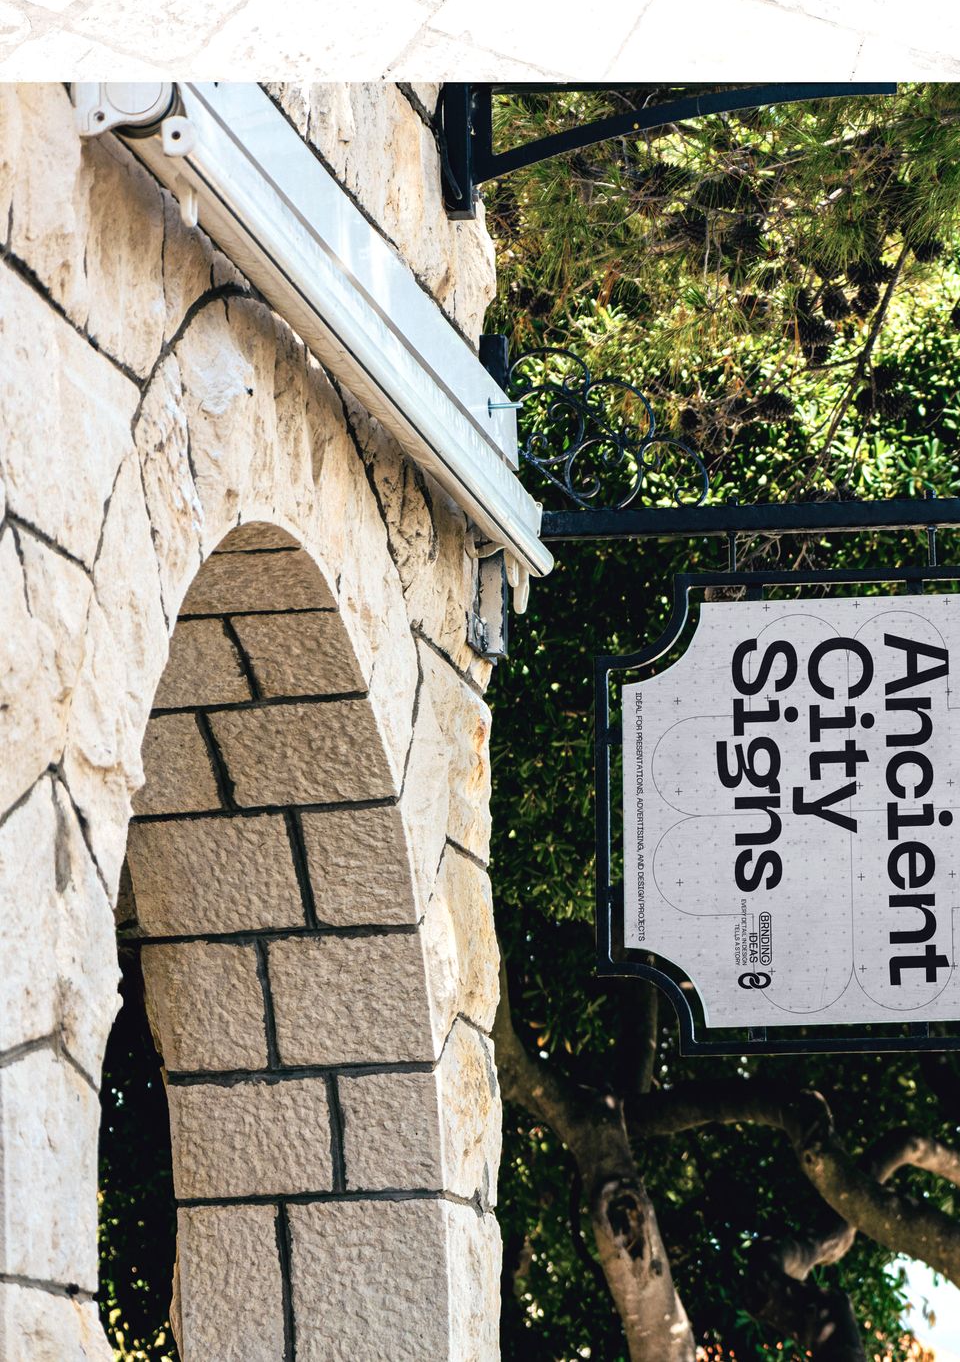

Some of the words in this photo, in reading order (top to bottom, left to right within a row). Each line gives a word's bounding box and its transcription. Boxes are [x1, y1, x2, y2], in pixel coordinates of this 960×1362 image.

[635, 692, 643, 714] IDEAL
[635, 715, 643, 731] FOR
[792, 636, 876, 834] City
[635, 732, 644, 796] PRESENTATIONS,
[716, 637, 799, 893] Signs
[636, 797, 645, 852] ADVERTISING,
[883, 632, 954, 987] Ancient
[637, 853, 645, 870] AND
[637, 871, 645, 901] DESIGN
[637, 903, 646, 942] PROJECTS
[760, 915, 770, 964] BRNDING
[749, 932, 758, 964] IDEAS
